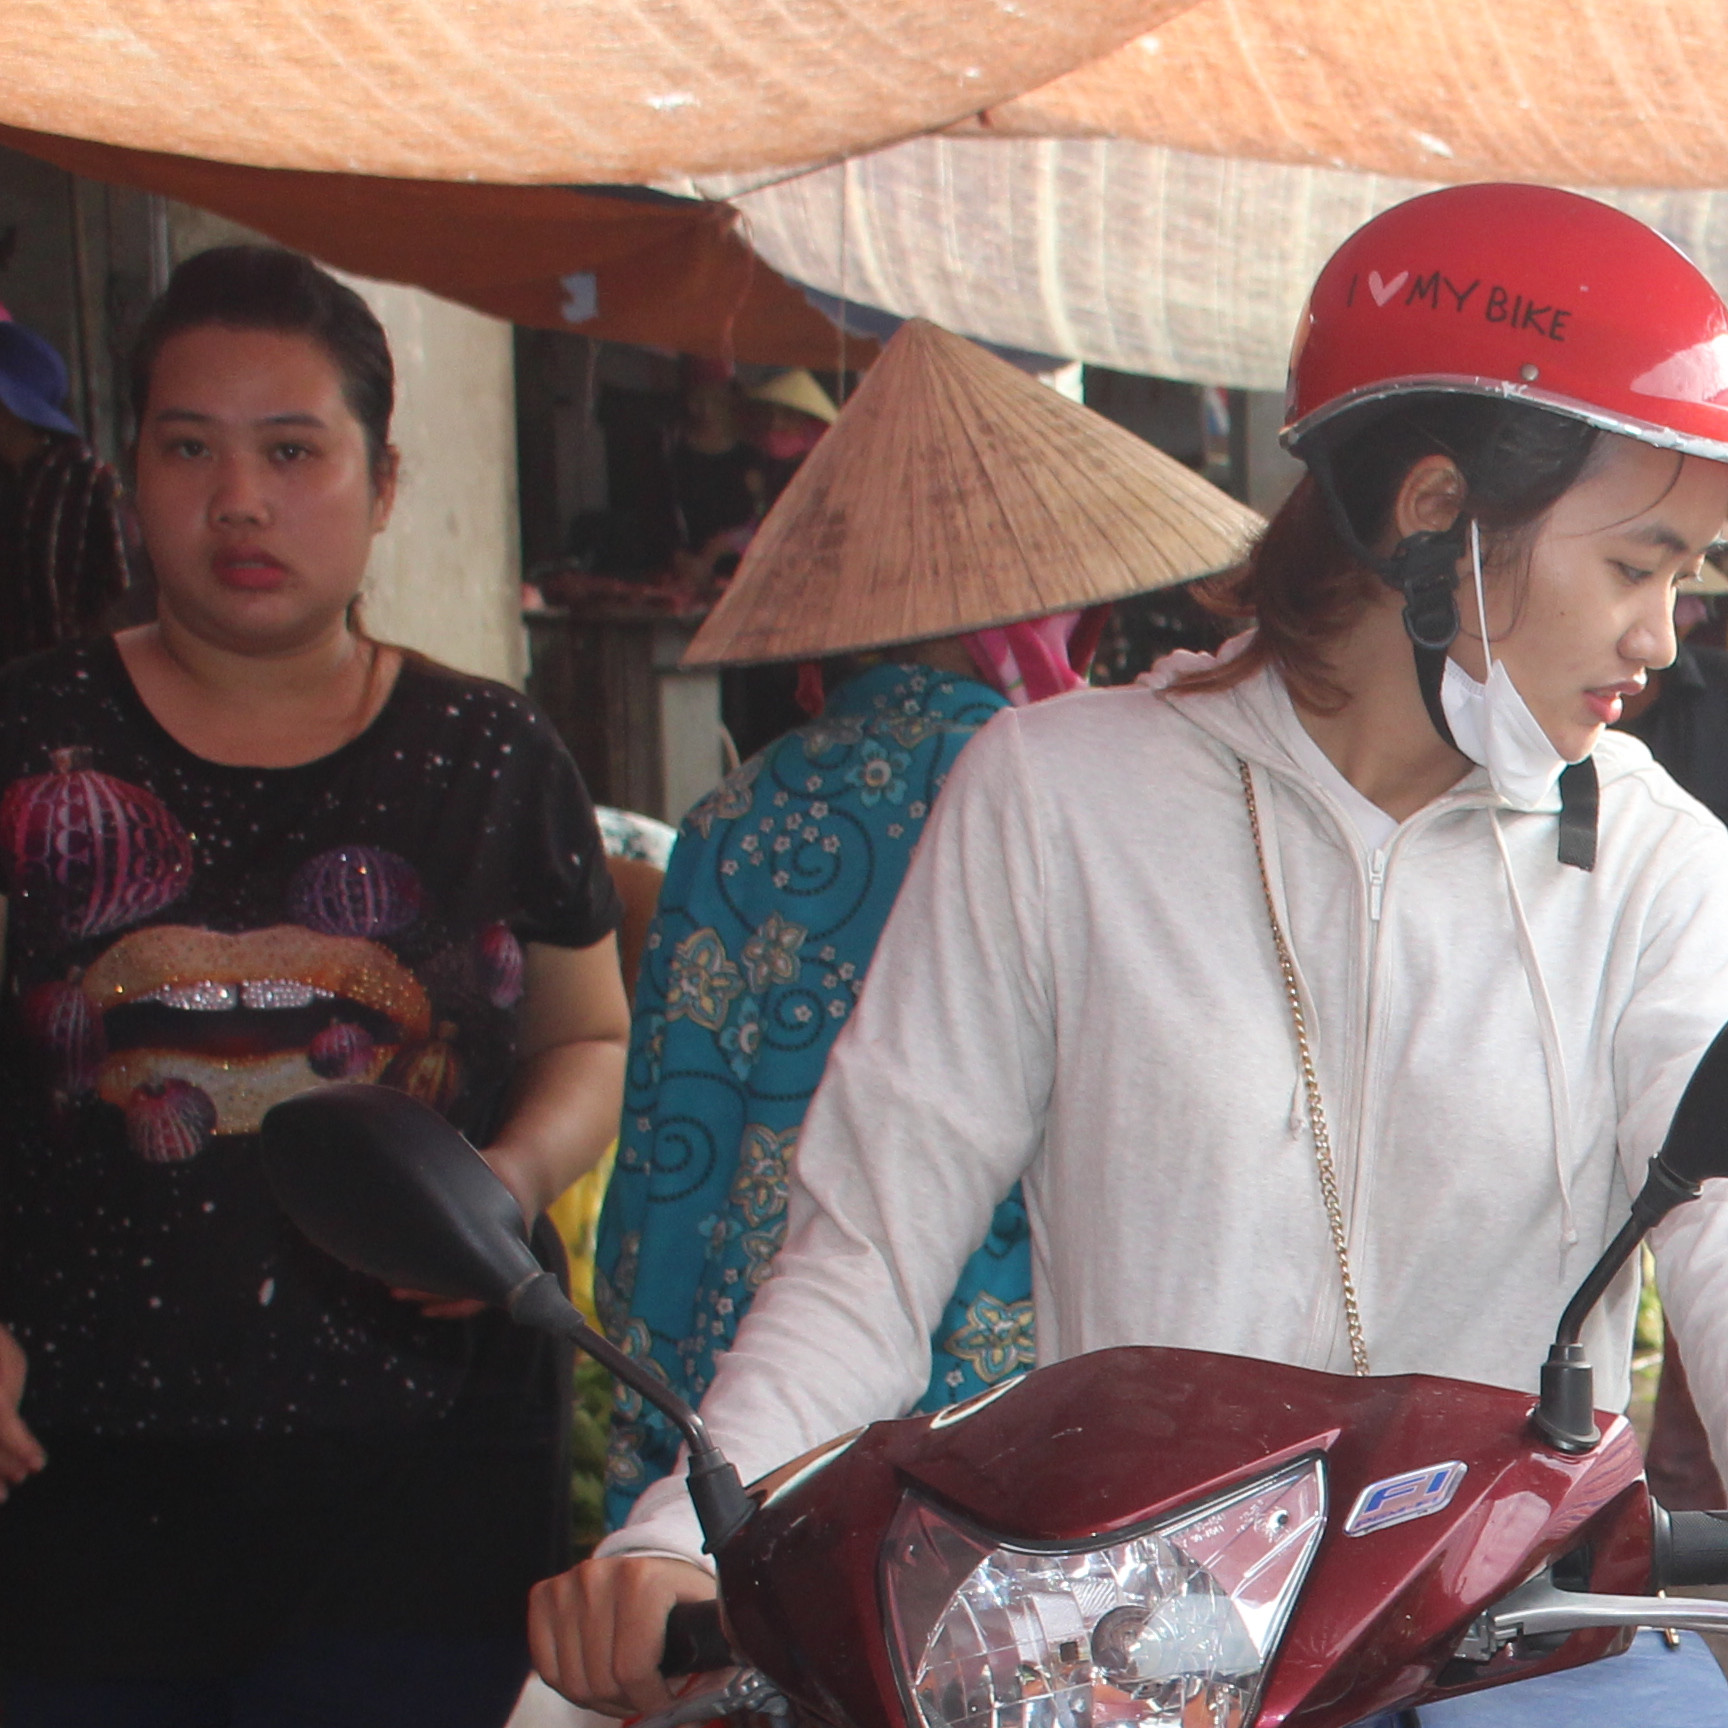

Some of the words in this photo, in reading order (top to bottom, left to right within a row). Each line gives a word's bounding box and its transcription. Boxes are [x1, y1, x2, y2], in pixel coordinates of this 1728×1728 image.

[1346, 273, 1359, 308] I
[1404, 270, 1481, 313] MY
[1484, 285, 1573, 342] BIKE
[1363, 1468, 1451, 1515] FI
